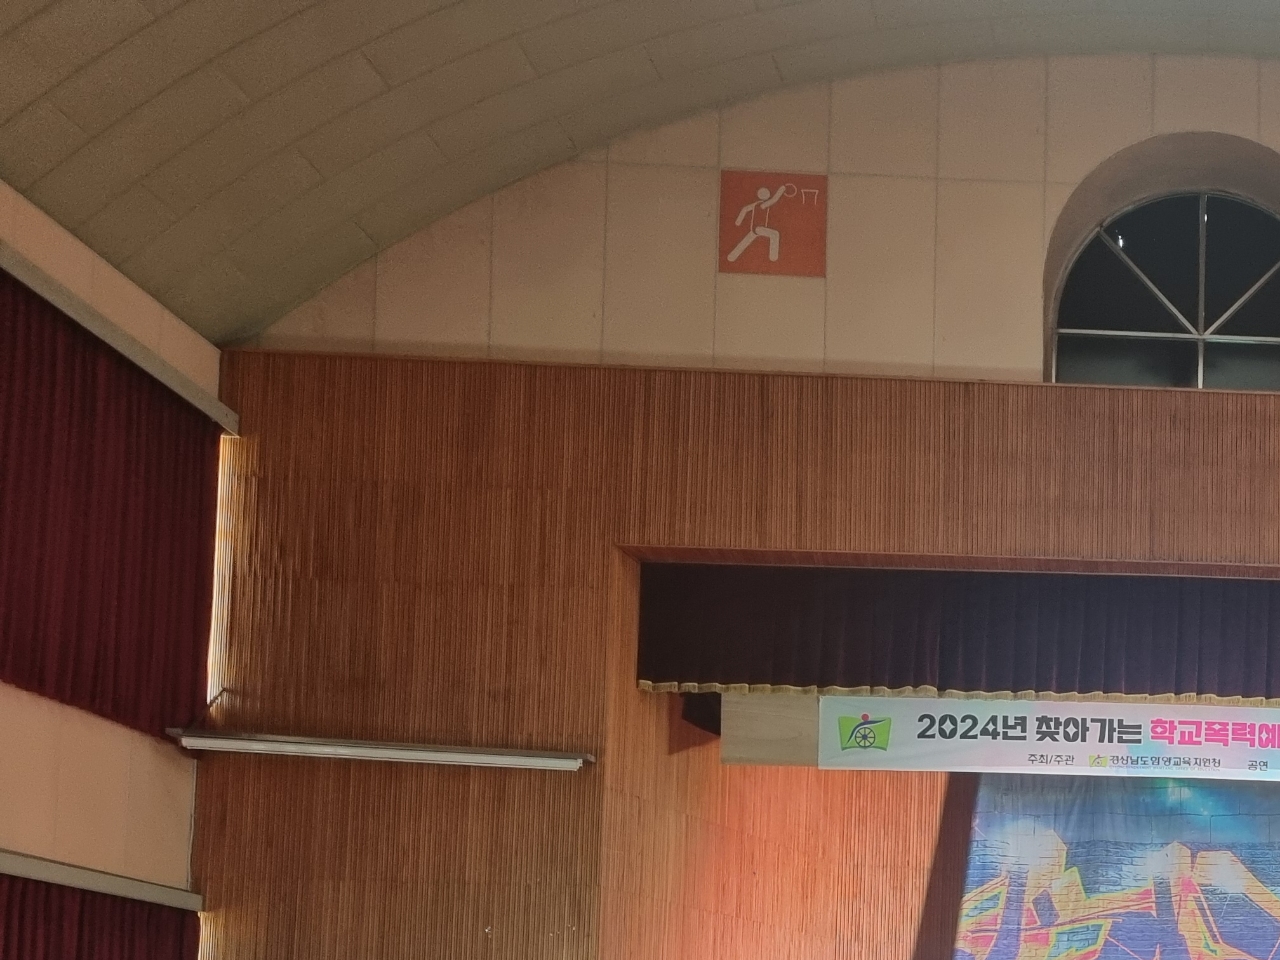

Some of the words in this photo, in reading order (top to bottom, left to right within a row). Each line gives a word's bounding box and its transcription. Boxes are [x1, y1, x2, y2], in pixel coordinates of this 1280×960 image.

[917, 713, 1028, 742] 2024년
[1035, 715, 1143, 745] 찾아가는
[1027, 754, 1075, 765] 주최/주관
[1109, 755, 1221, 768] 경상남도함양교육지원청
[1247, 760, 1269, 772] 공연
